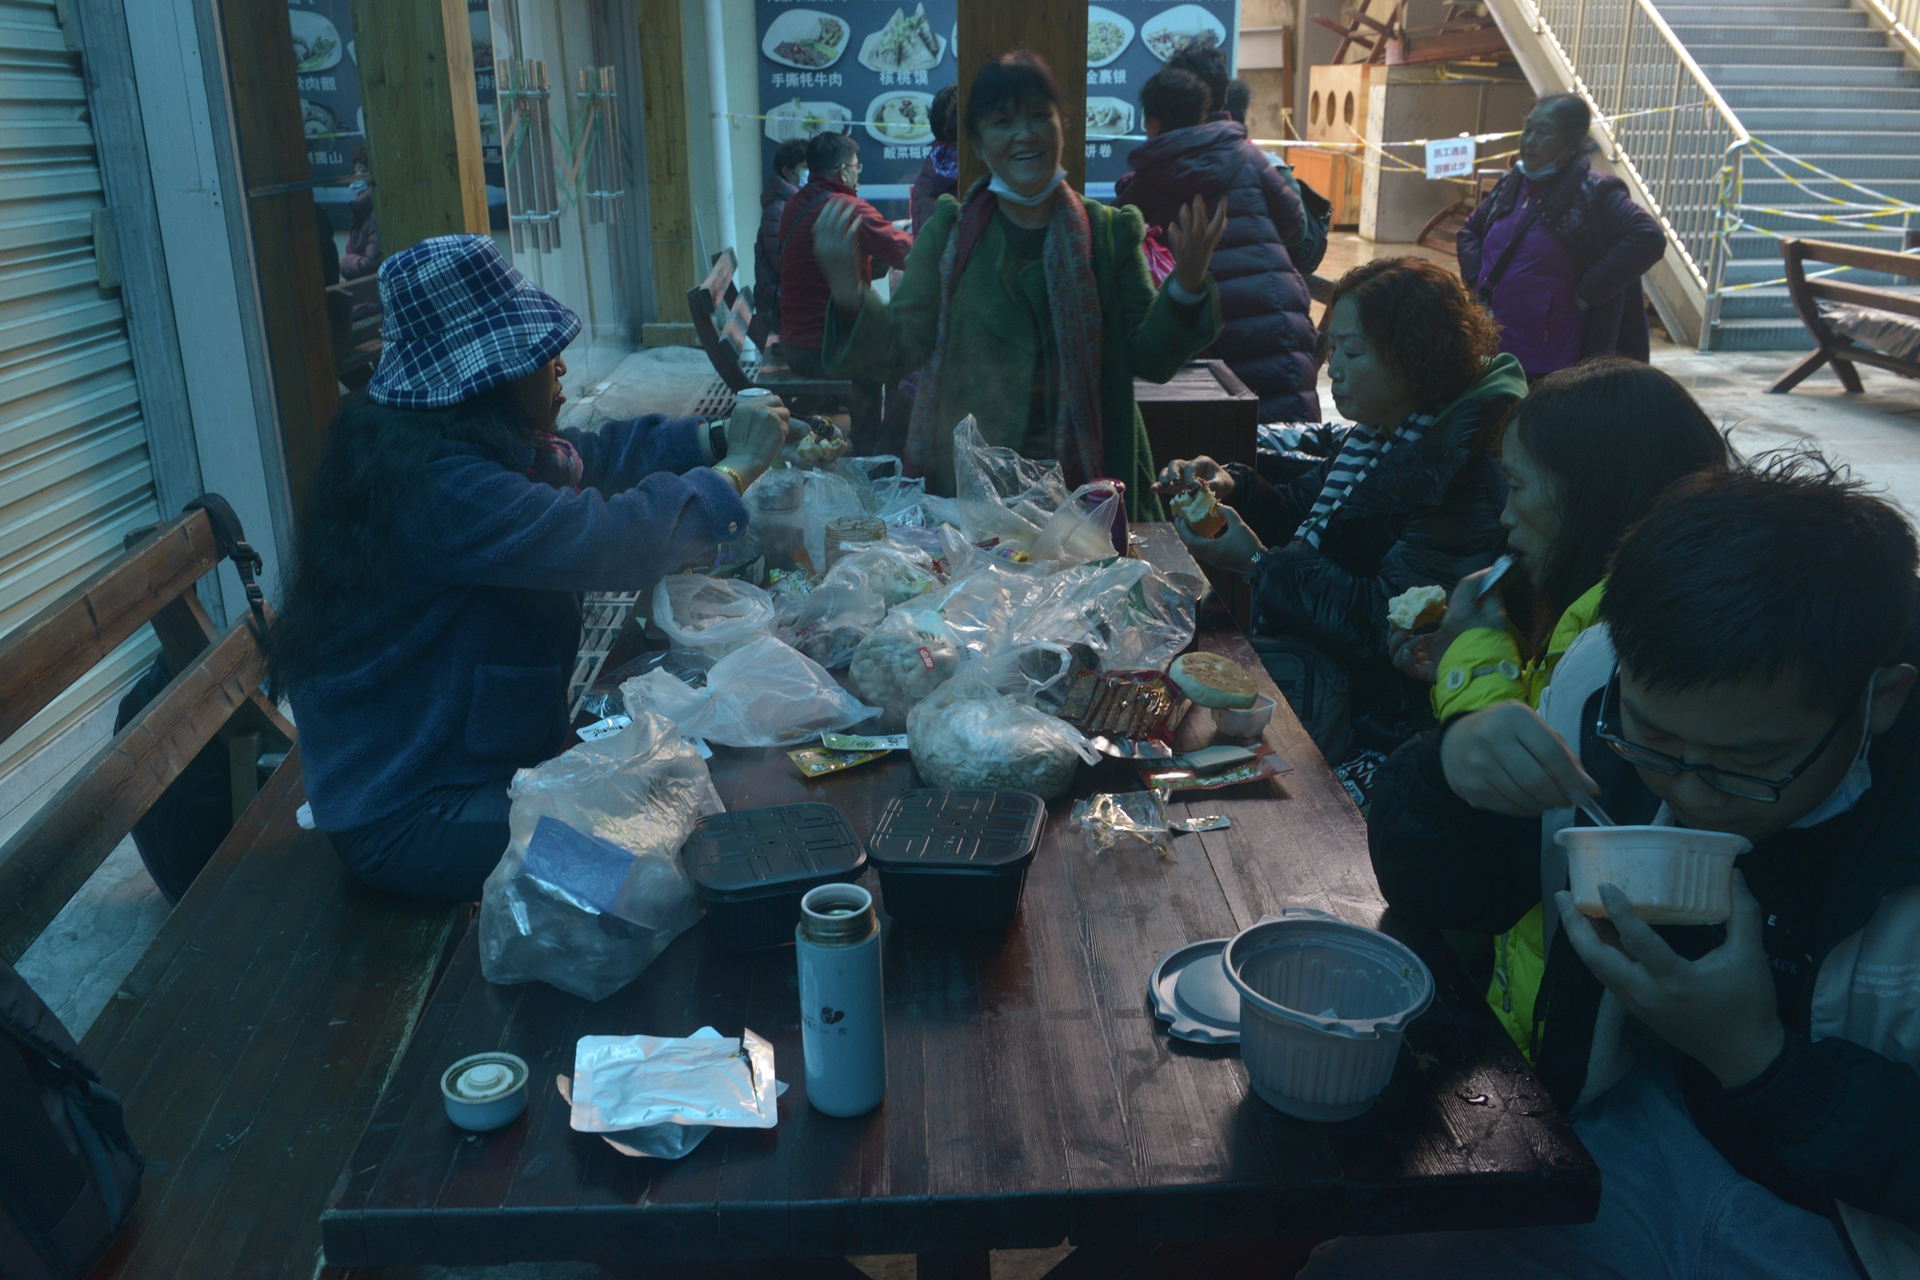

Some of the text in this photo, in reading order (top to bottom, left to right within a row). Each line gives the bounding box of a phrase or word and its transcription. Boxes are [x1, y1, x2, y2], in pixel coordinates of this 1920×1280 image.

[771, 72, 842, 88] 手撕牦牛肉
